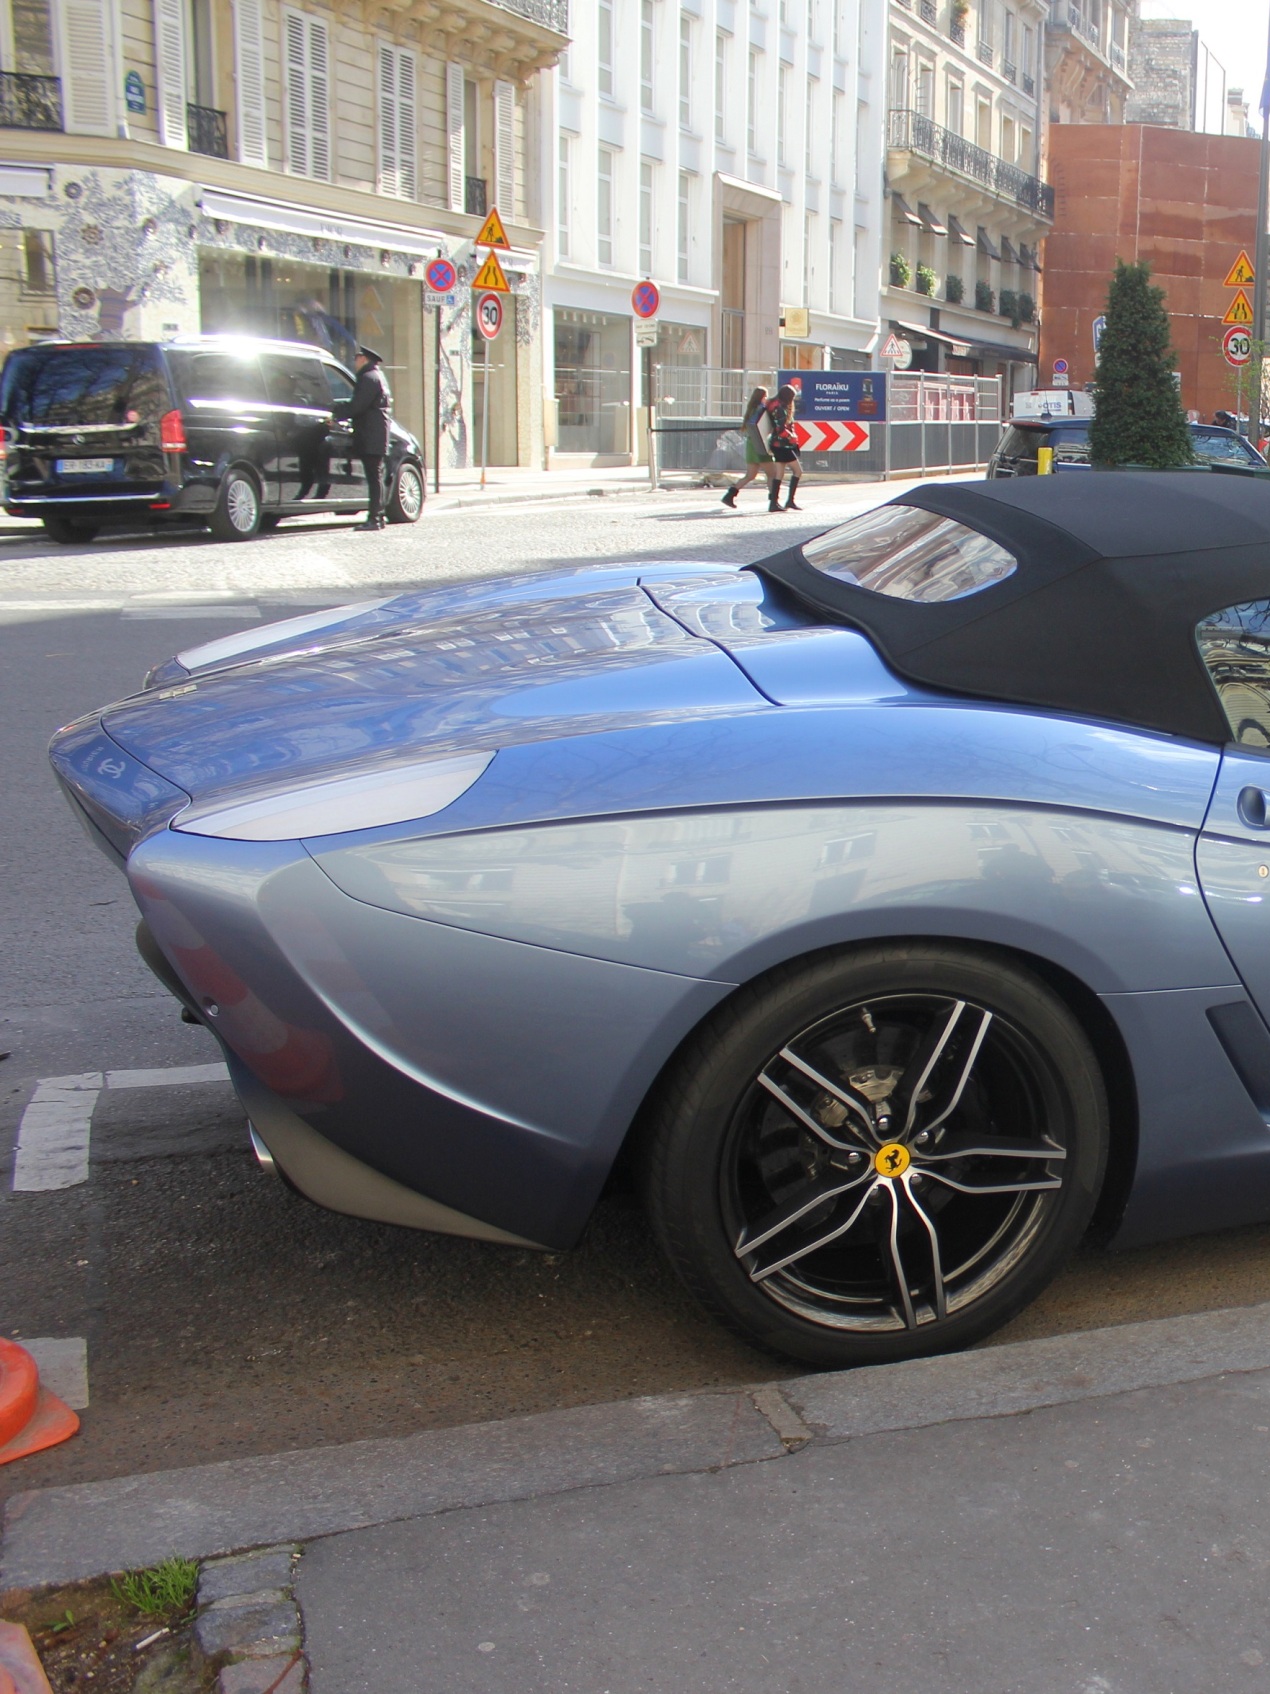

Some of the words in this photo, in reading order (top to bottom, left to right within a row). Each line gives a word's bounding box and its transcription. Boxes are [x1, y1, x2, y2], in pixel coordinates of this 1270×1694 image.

[426, 294, 446, 302] SAUF
[483, 305, 498, 326] 30
[1229, 337, 1250, 355] 30
[815, 382, 849, 391] FLORAÏKU
[1043, 401, 1062, 409] OTIS
